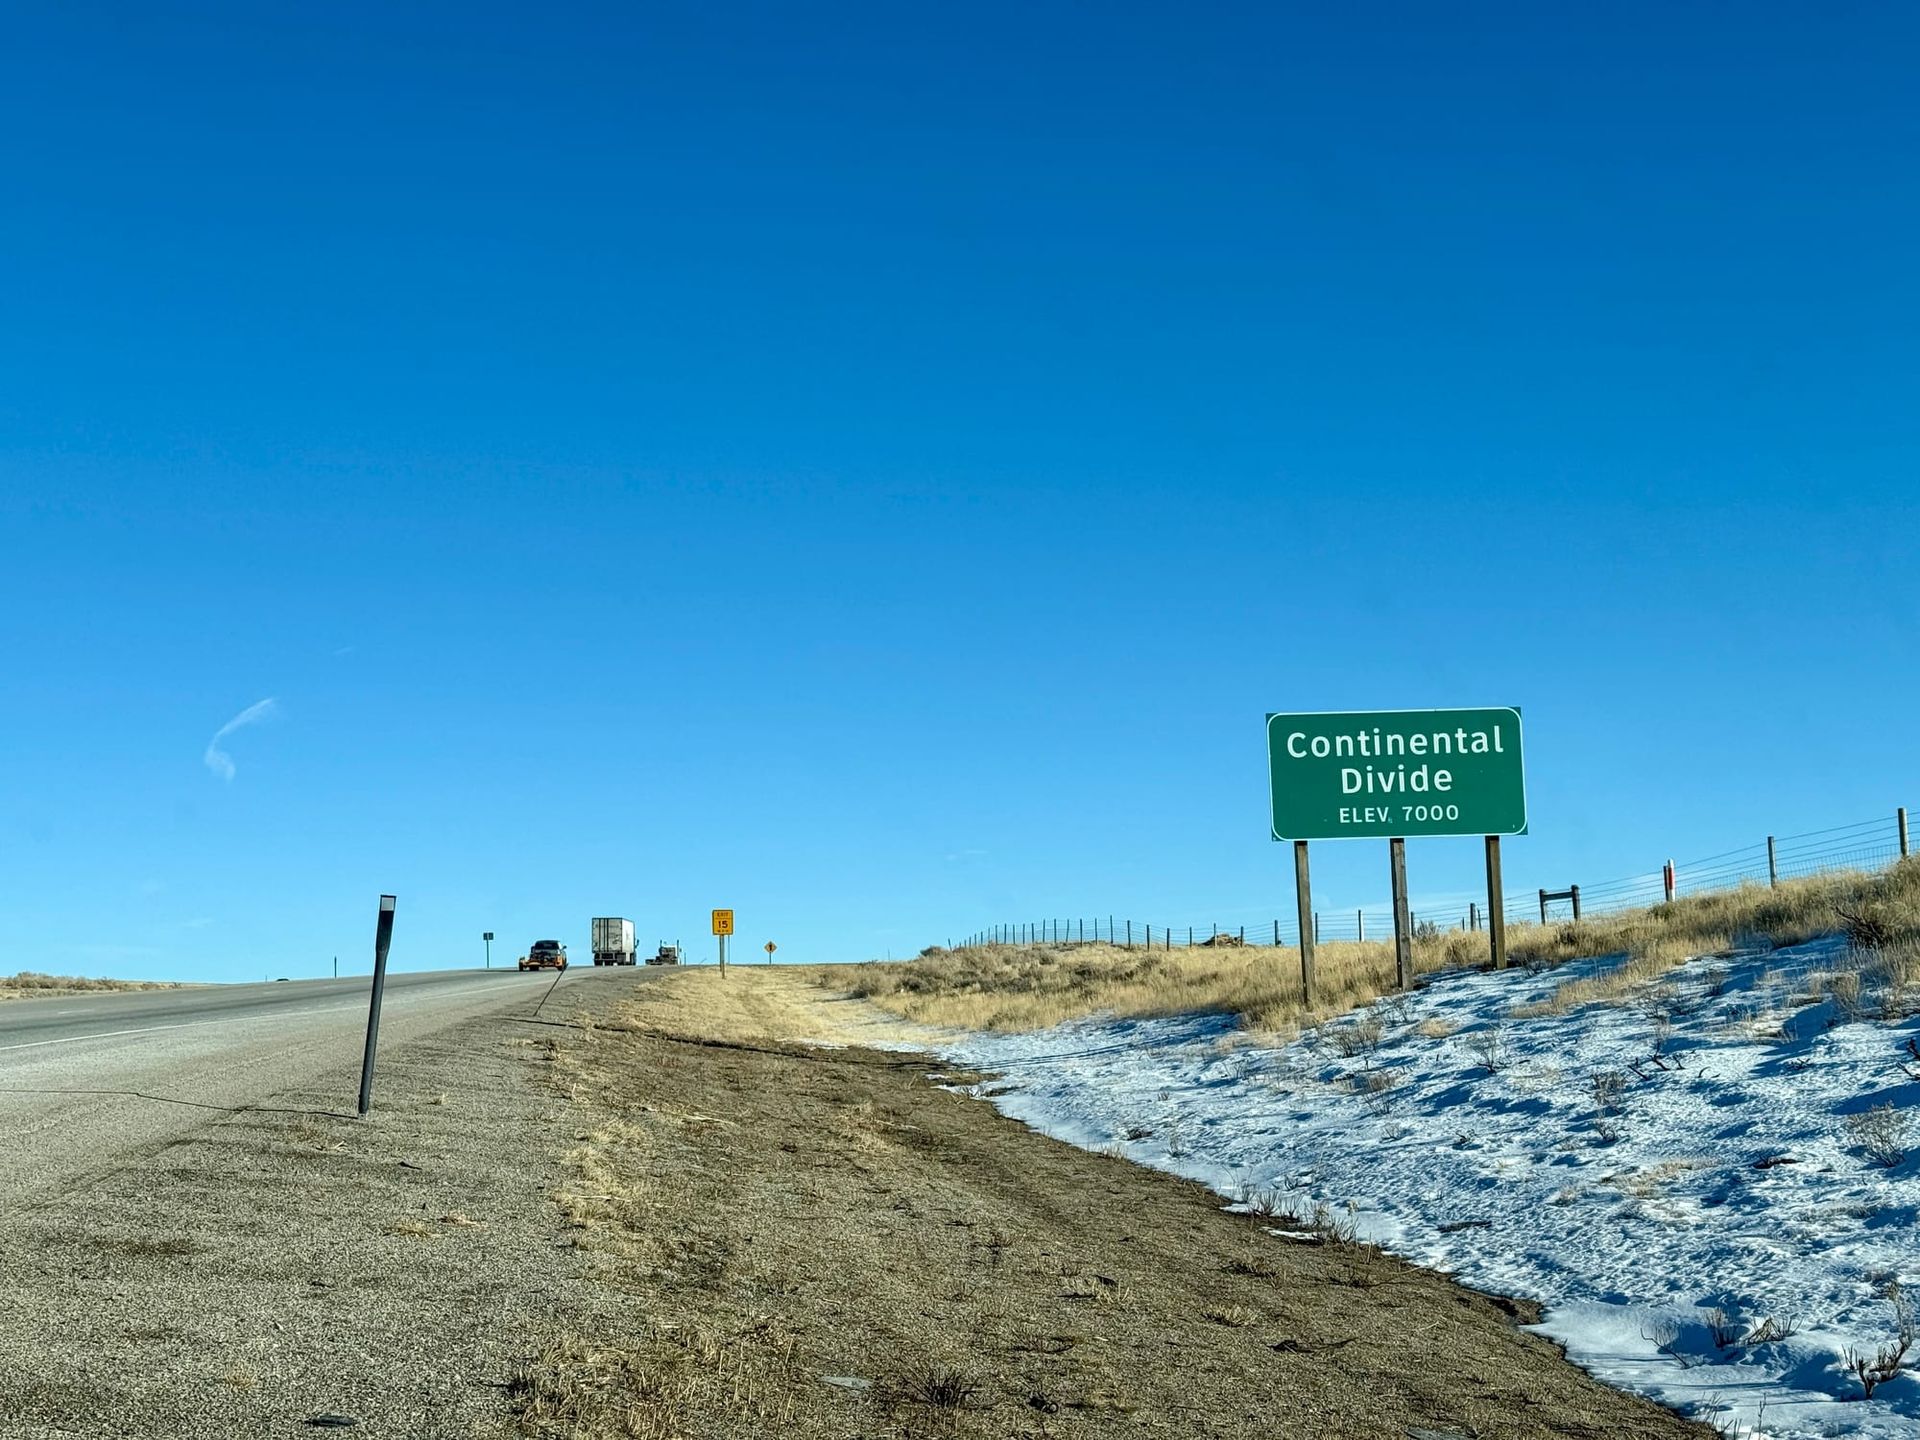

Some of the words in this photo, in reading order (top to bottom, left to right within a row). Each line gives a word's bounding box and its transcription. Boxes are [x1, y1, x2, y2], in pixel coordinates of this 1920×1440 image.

[1286, 725, 1504, 758] Continental
[1341, 764, 1453, 794] Divide
[1402, 804, 1460, 822] 7000
[718, 920, 729, 929] 15
